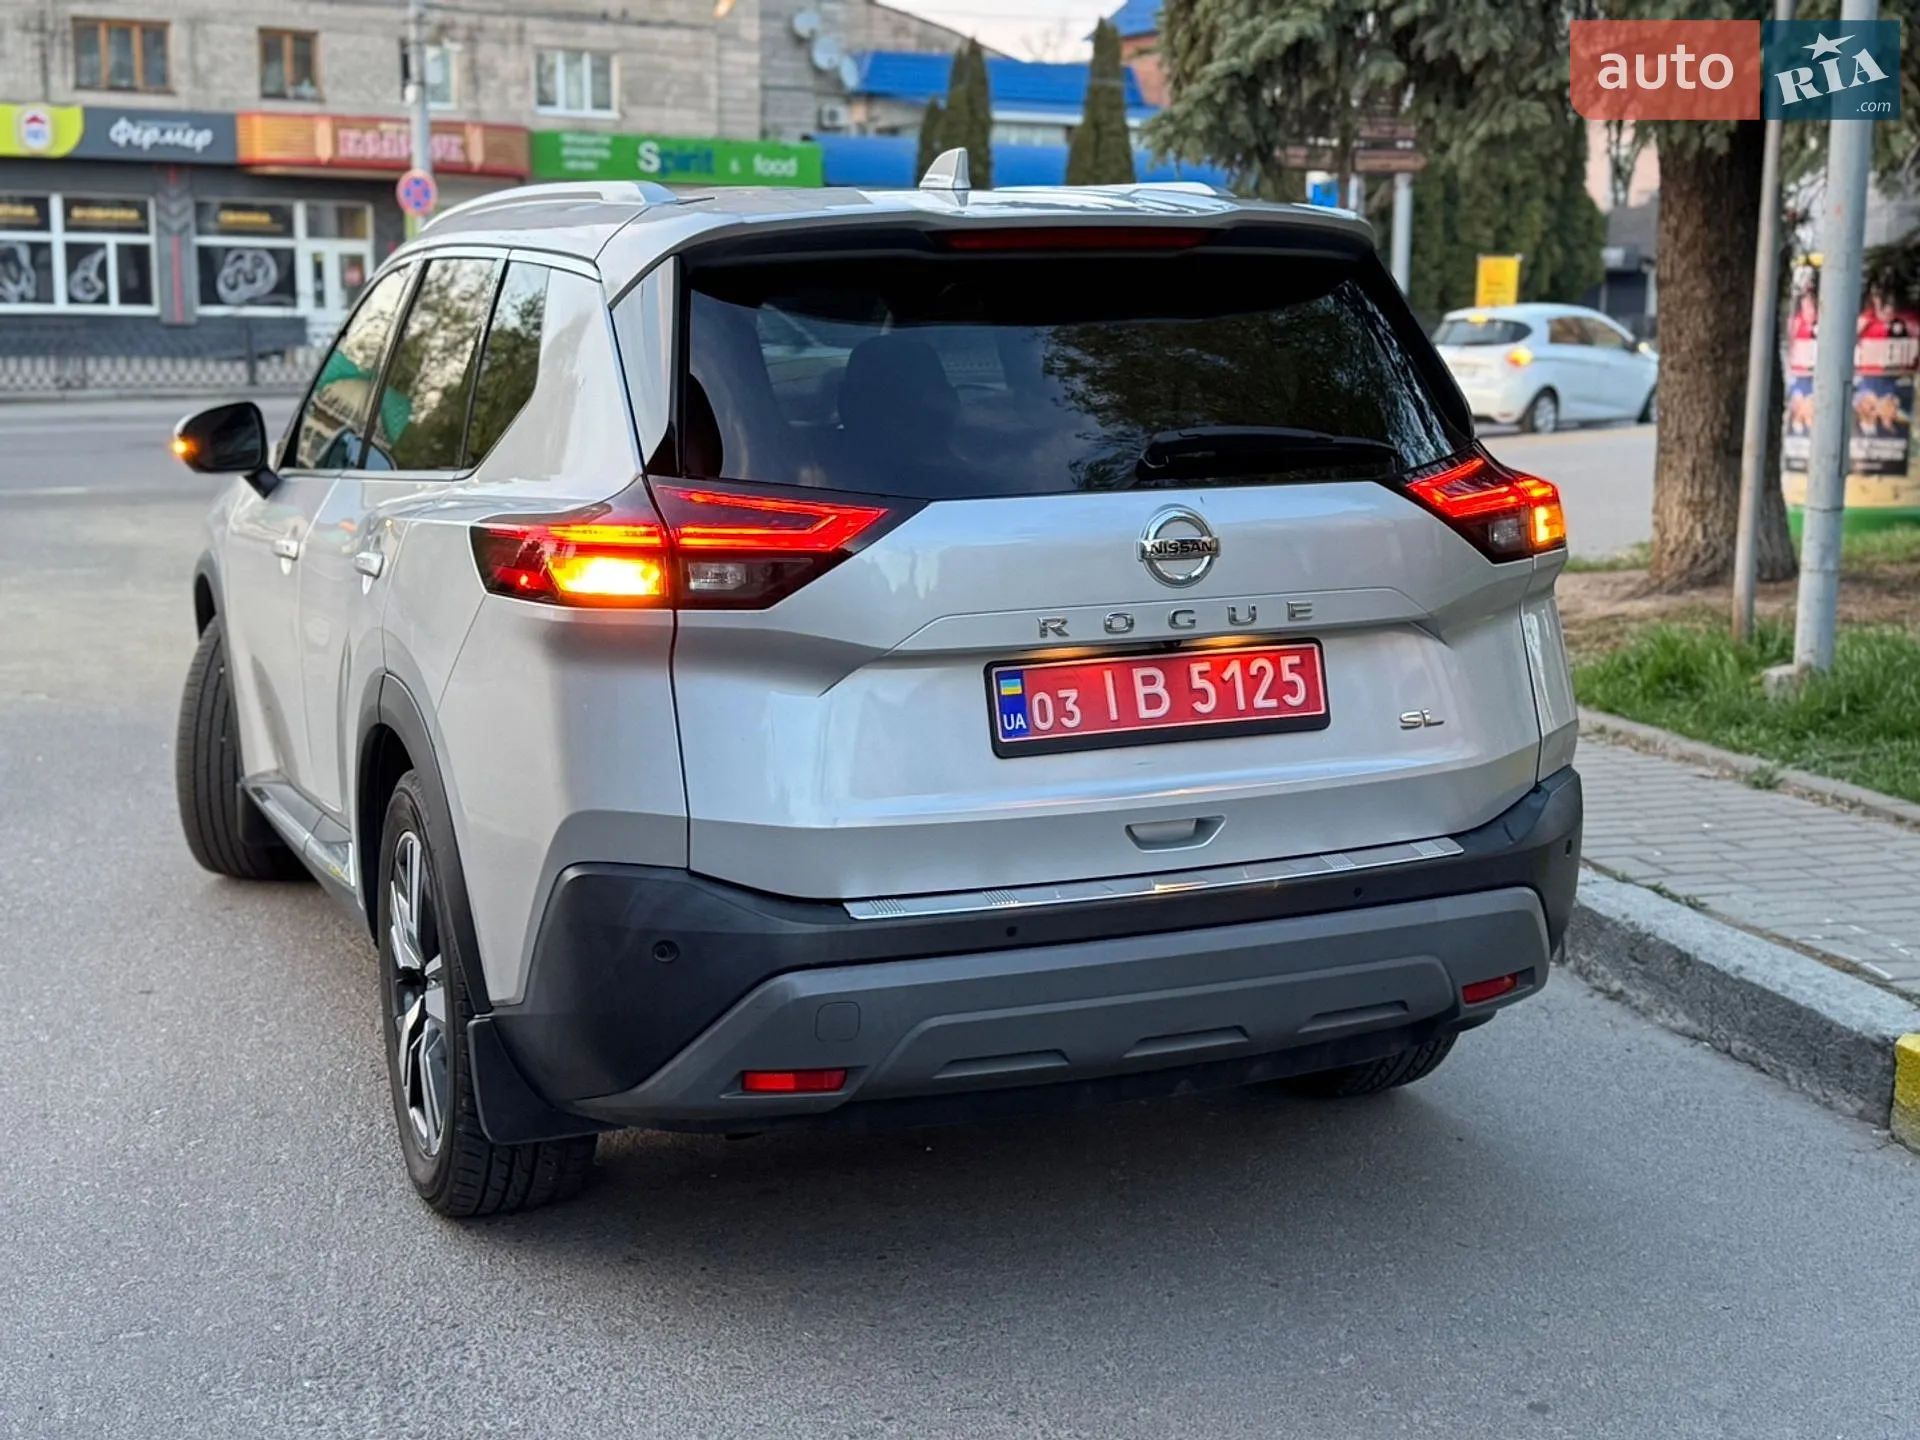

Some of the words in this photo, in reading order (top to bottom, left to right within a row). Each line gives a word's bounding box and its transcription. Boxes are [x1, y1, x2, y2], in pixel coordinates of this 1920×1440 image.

[109, 117, 214, 154] Фермер
[637, 140, 715, 178] Spirit
[752, 152, 799, 178] food
[1149, 540, 1214, 556] NISSAN
[1036, 601, 1314, 639] ROGUE
[1031, 688, 1082, 732] 03
[1188, 655, 1307, 715] 5125
[1003, 712, 1027, 731] UA
[1400, 709, 1445, 731] SL
